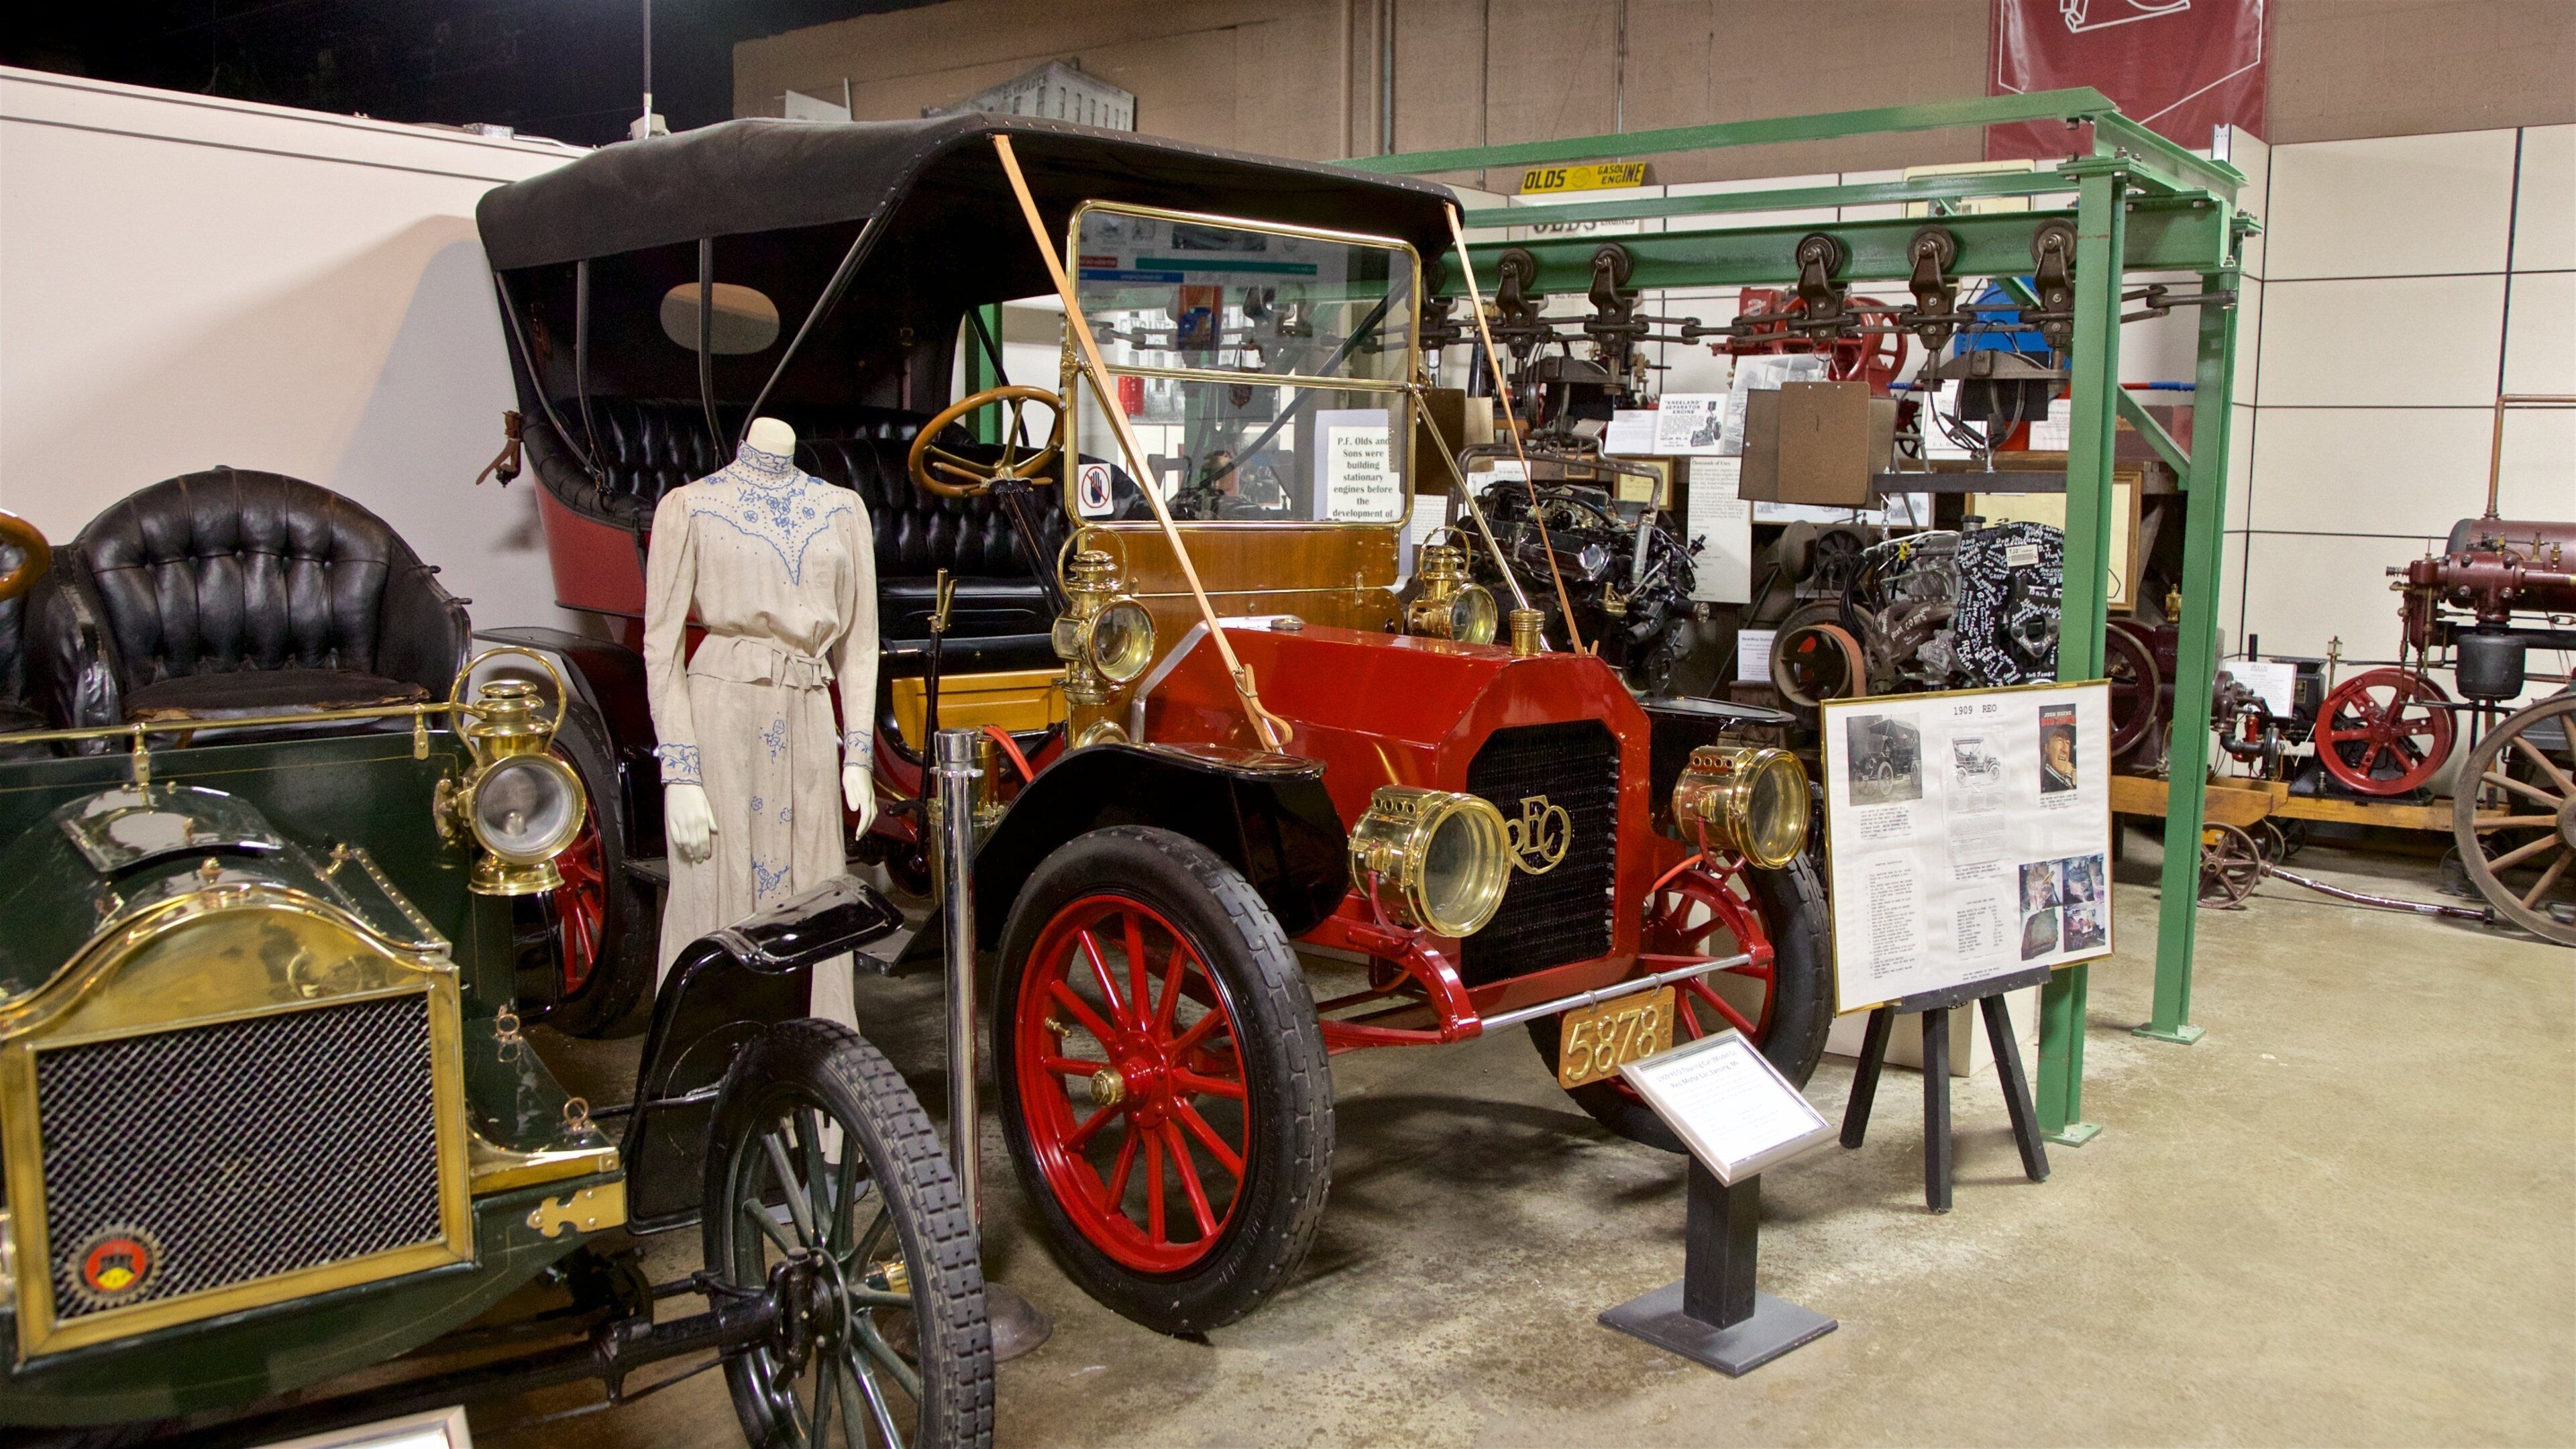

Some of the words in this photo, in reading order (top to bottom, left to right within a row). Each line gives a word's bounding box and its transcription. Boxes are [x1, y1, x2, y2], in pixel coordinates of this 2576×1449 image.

[1524, 170, 1566, 189] OLDS
[1338, 437, 1352, 445] P.F.
[1343, 449, 1362, 458] Sons
[1347, 462, 1380, 470] building
[1343, 473, 1383, 482] stationary
[1334, 486, 1364, 495] engines
[1356, 497, 1370, 505] the
[1332, 509, 1383, 519] development
[1385, 509, 1393, 517] of
[1962, 640, 1974, 660] RICK
[1953, 706, 1973, 715] 1909
[1982, 704, 1997, 713] REO
[1506, 795, 1571, 875] REO
[1566, 1005, 1659, 1081] 5878
[1681, 1063, 1703, 1075] Touring
[1701, 1059, 1711, 1067] Car
[1680, 1075, 1699, 1085] Motor
